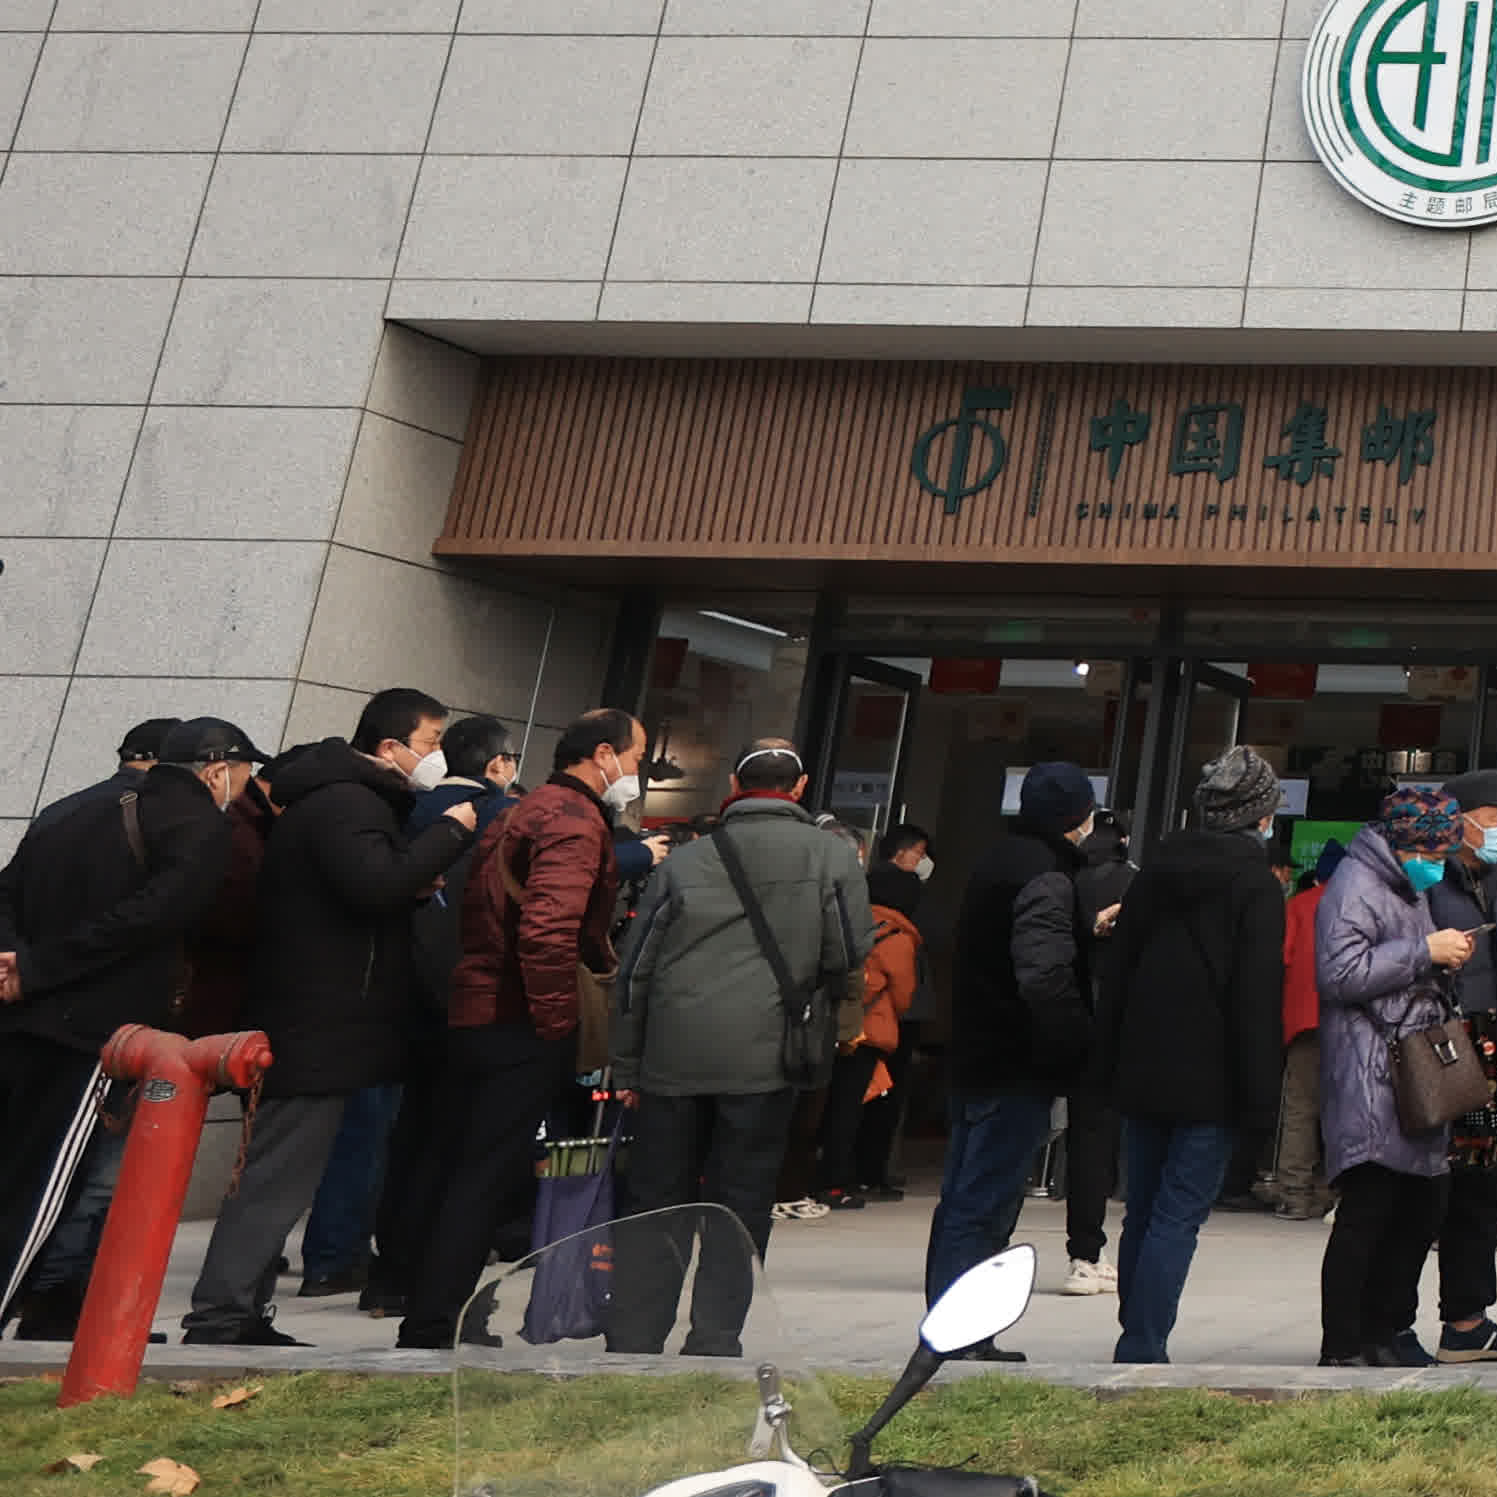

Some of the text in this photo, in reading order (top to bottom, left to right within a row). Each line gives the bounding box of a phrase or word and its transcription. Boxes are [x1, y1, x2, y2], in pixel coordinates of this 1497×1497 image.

[1089, 400, 1438, 485] 中国集邮
[1075, 501, 1427, 527] CHINA PHILATELY
